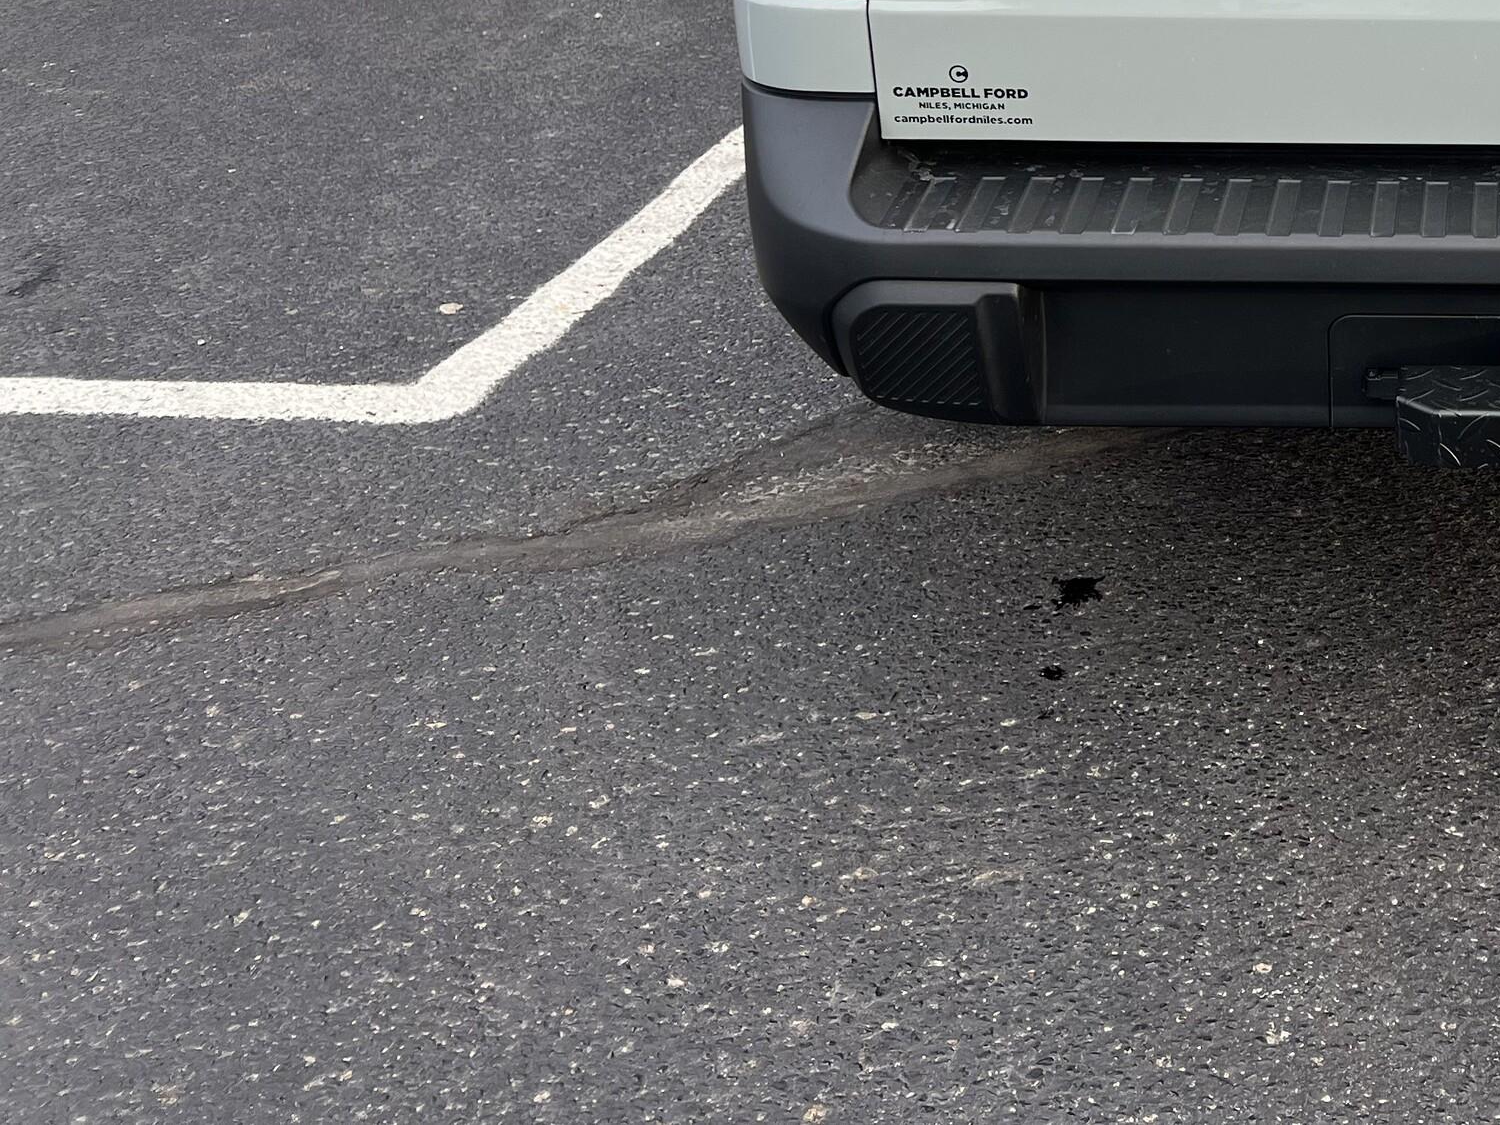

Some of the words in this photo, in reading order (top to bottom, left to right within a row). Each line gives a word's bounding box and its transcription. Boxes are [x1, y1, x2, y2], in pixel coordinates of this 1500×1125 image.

[893, 87, 980, 98] CAMPBELL
[984, 88, 1028, 99] FORD
[919, 102, 951, 110] NILES,
[894, 115, 1033, 124] campbellfordniles.com
